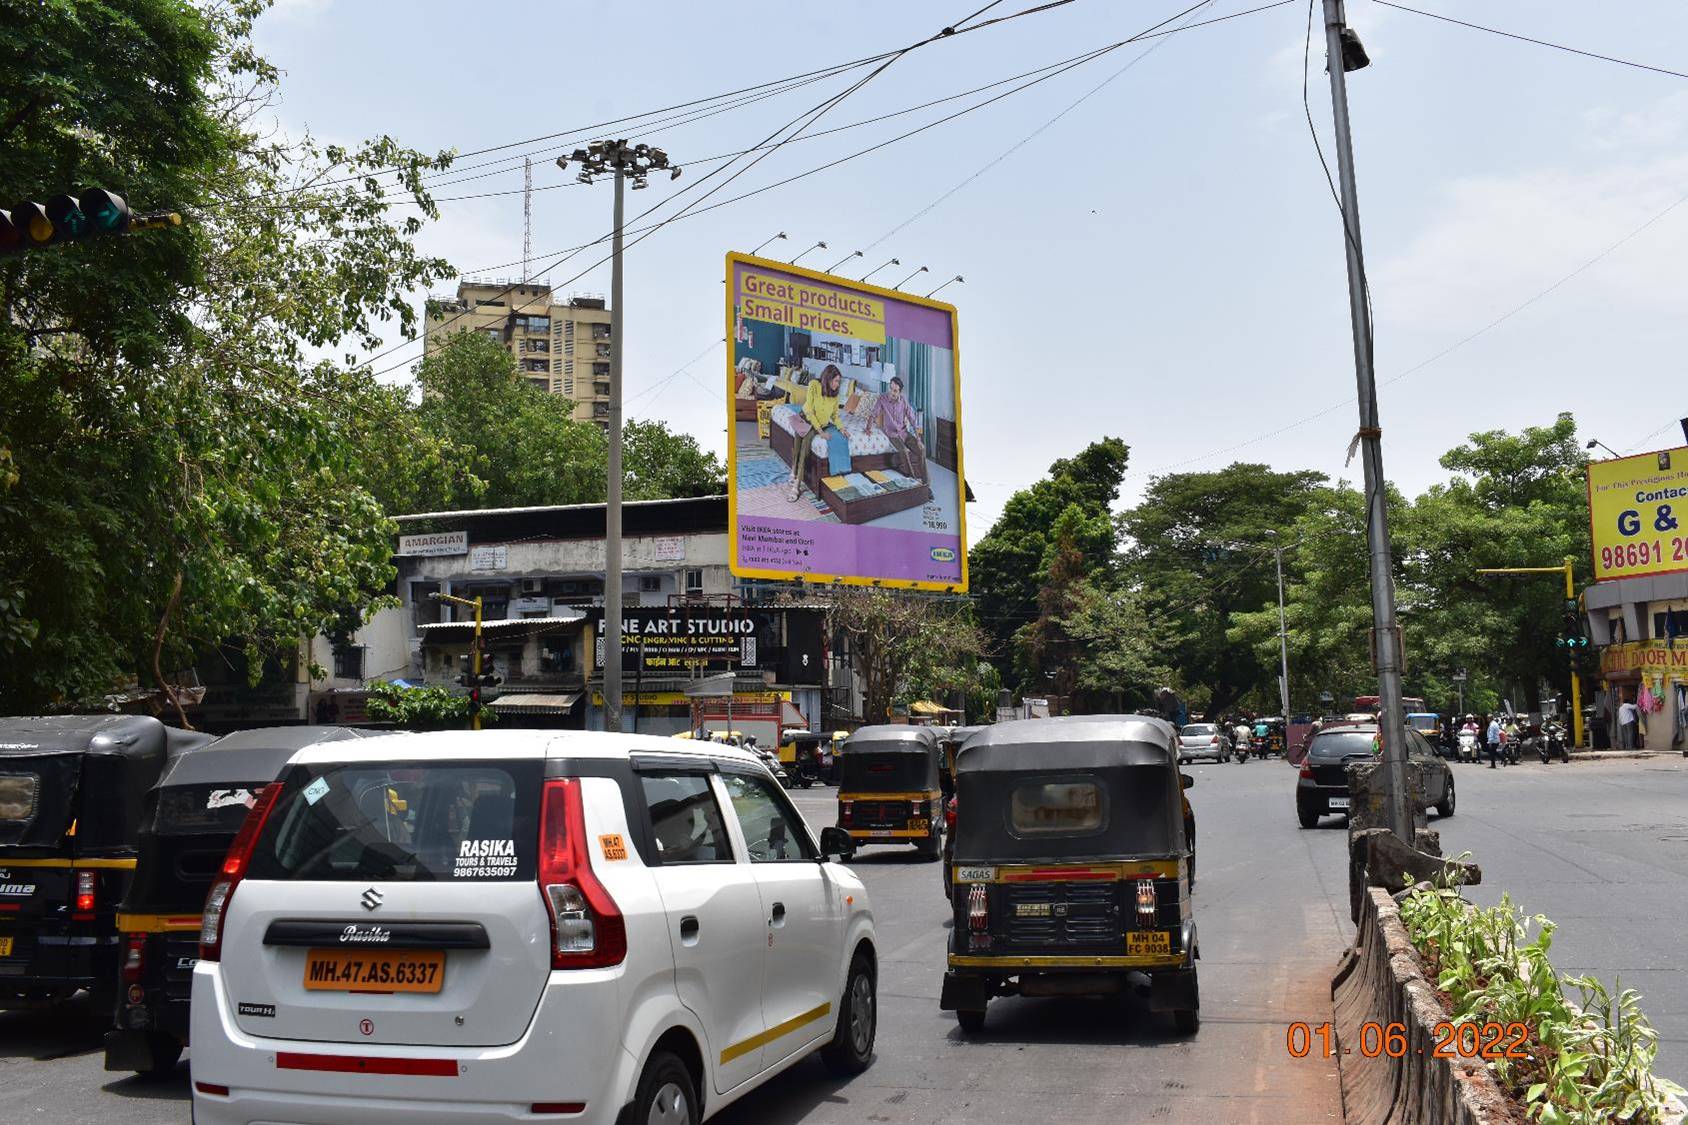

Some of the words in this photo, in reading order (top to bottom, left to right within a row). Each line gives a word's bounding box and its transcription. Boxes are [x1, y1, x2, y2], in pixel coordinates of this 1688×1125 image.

[745, 274, 795, 301] Great
[799, 289, 877, 318] products.
[744, 298, 795, 324] Small
[799, 312, 855, 336] prices.
[1617, 509, 1641, 536] G
[1654, 504, 1679, 532] &
[1601, 540, 1662, 570] 98691
[644, 618, 681, 634] ART
[687, 618, 755, 634] STUDIO
[459, 839, 515, 857] RASIKA
[455, 857, 478, 867] TOURS
[480, 857, 486, 866] &
[487, 856, 518, 866] TRAVELS
[453, 867, 517, 877] 9867635097
[339, 924, 391, 942] Rasika
[1132, 934, 1149, 943] MH
[1151, 933, 1165, 943] 04
[1129, 944, 1141, 954] FC
[1144, 943, 1169, 954] 9038
[309, 960, 439, 984] MH.47.AS.6337
